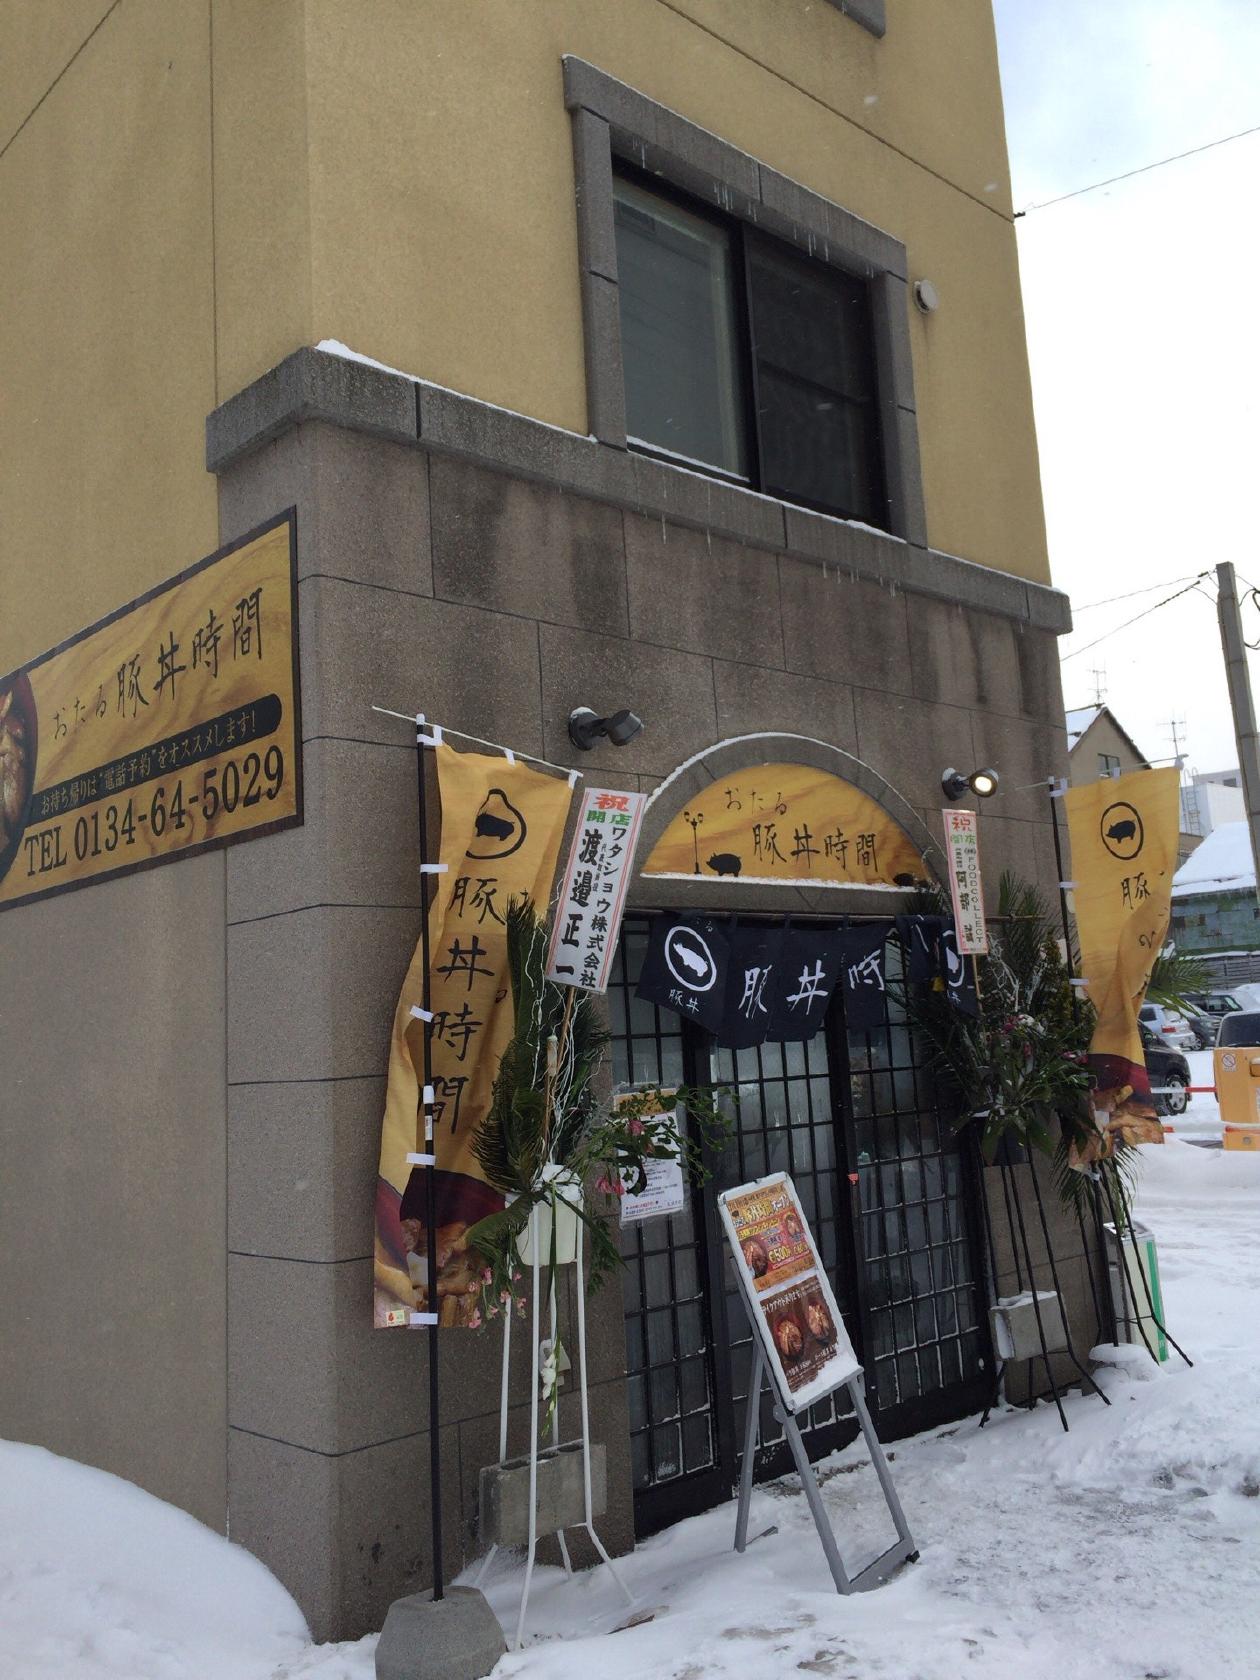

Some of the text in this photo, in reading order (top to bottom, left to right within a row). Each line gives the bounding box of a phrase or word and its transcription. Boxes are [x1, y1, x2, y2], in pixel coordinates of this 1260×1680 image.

[24, 745, 284, 877] TEL 0134-64-5029
[593, 793, 630, 812] 祝
[725, 786, 787, 816] おたる
[586, 809, 632, 827] 開店
[752, 823, 879, 873] 豚丼時間
[579, 827, 627, 989] ワタショウ株式会社
[668, 987, 701, 1015] 豚丼
